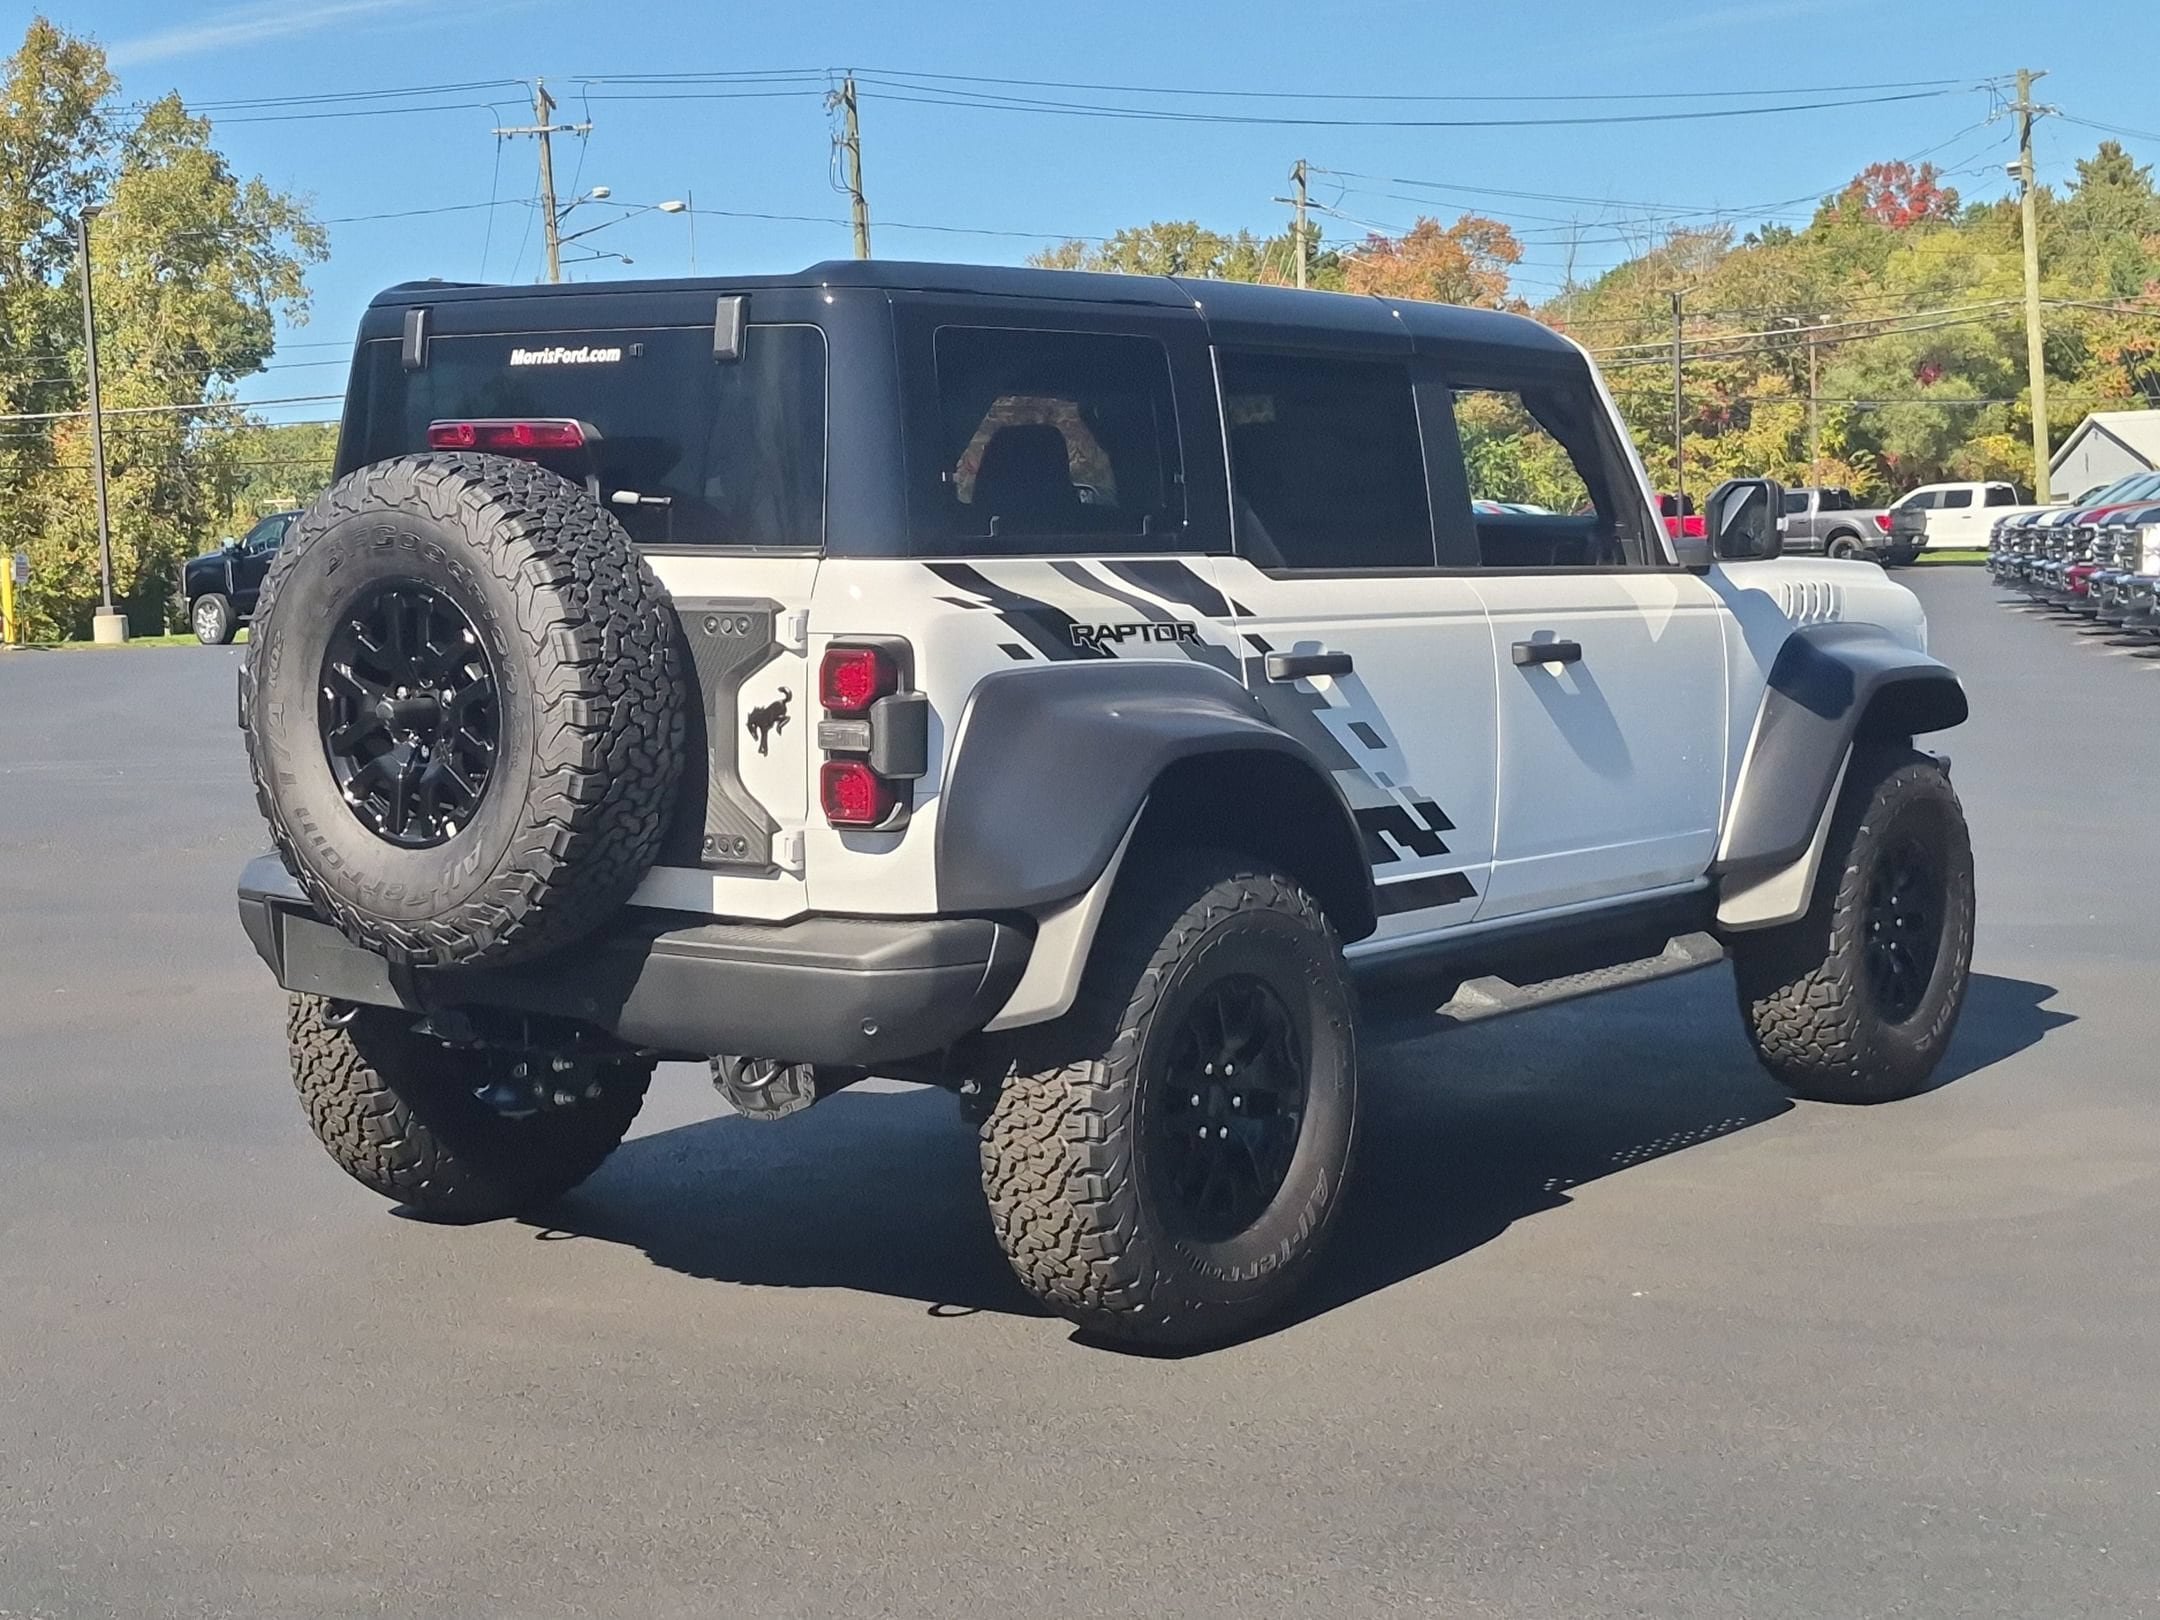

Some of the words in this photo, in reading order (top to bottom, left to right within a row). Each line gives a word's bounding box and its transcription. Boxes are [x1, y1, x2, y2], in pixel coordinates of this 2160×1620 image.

[510, 345, 622, 367] MorrisFord.com
[327, 523, 519, 695] BFGoodrich
[1069, 619, 1205, 656] RAPTOR
